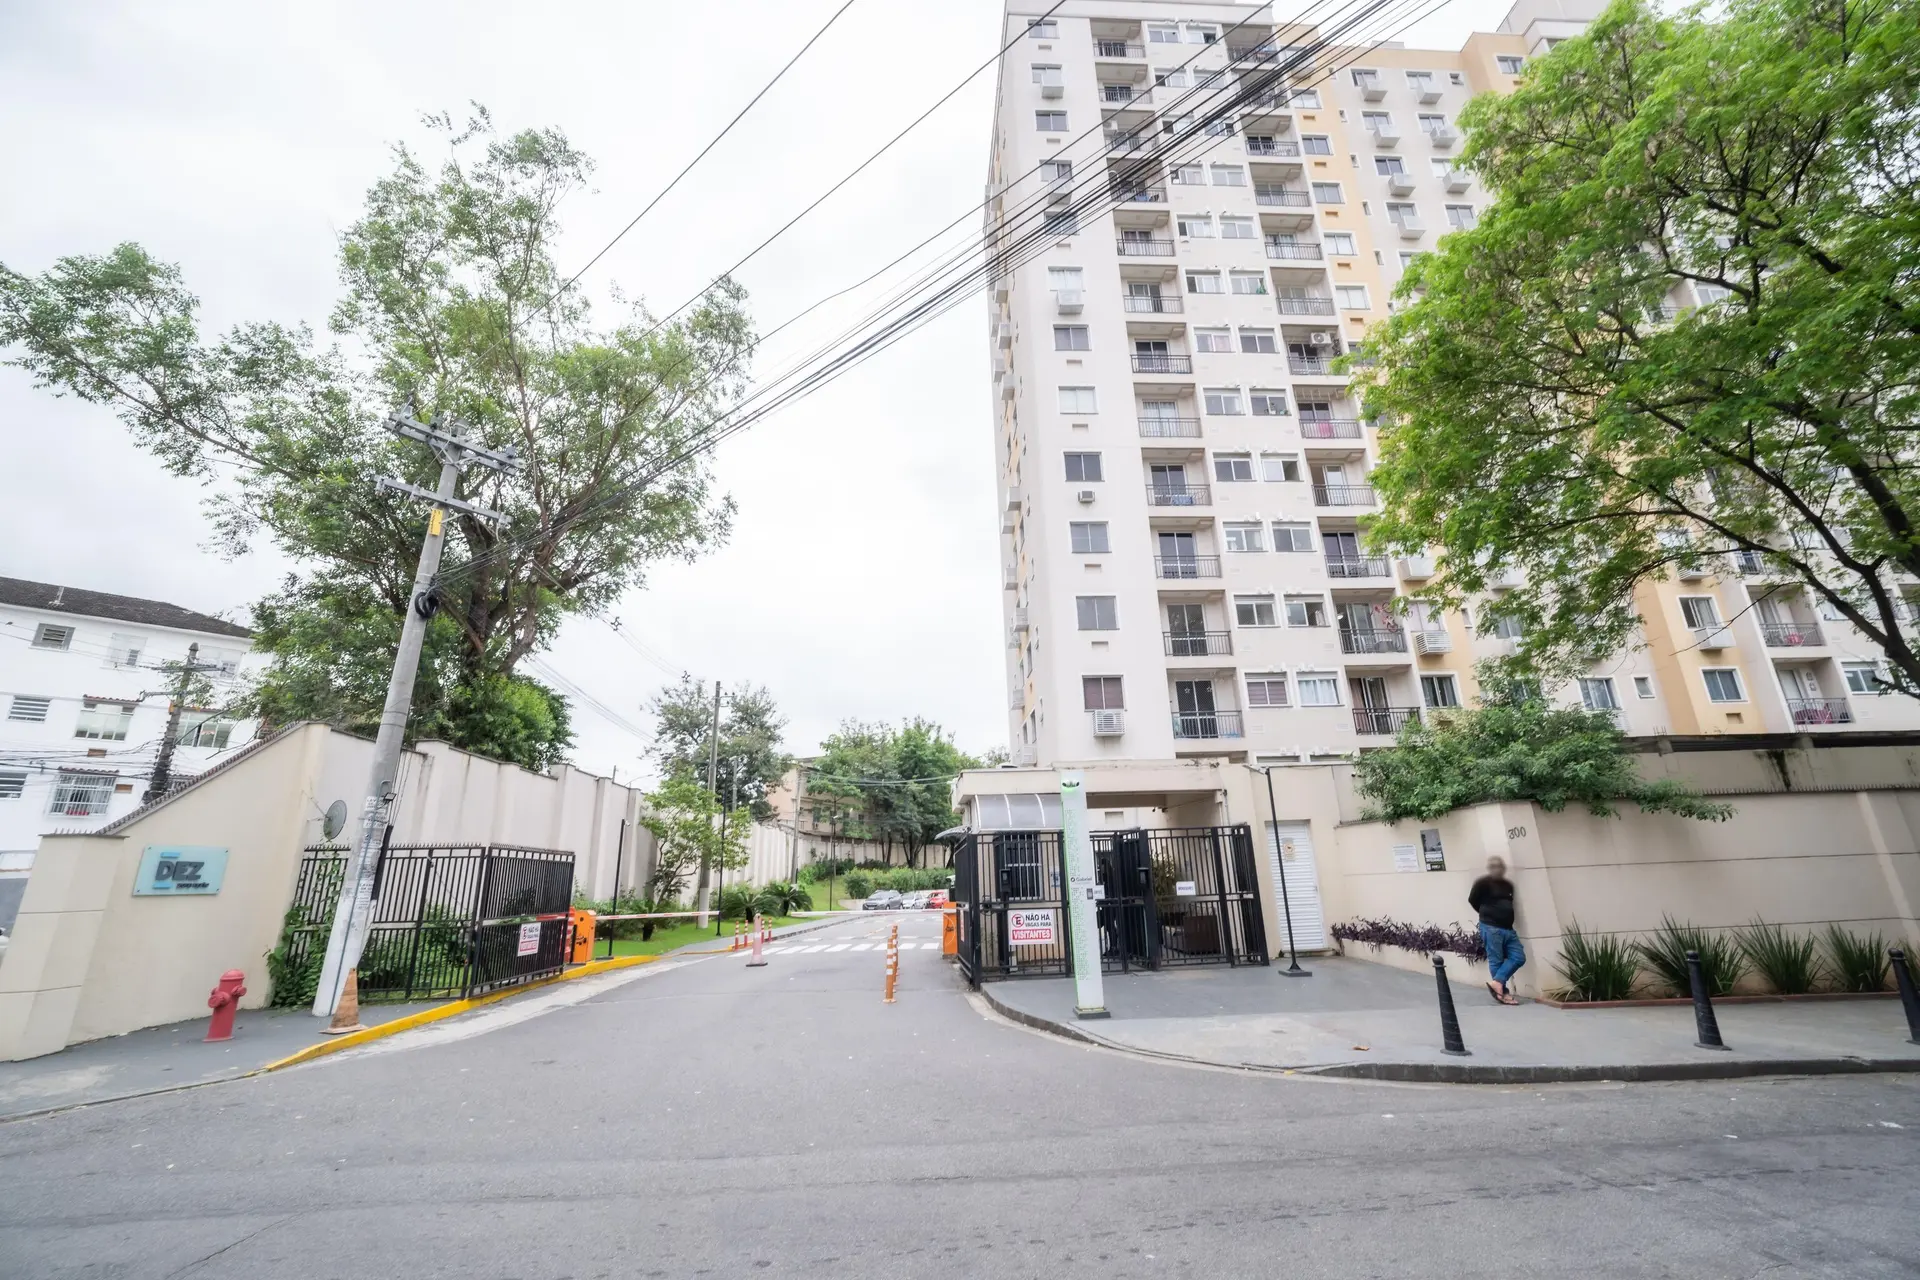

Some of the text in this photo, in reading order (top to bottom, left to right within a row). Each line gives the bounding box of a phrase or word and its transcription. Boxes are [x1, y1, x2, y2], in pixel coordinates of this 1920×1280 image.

[1508, 826, 1526, 839] 300
[155, 861, 205, 881] DEZ
[1025, 913, 1040, 921] NÃO
[1013, 930, 1050, 939] VISITANTES
